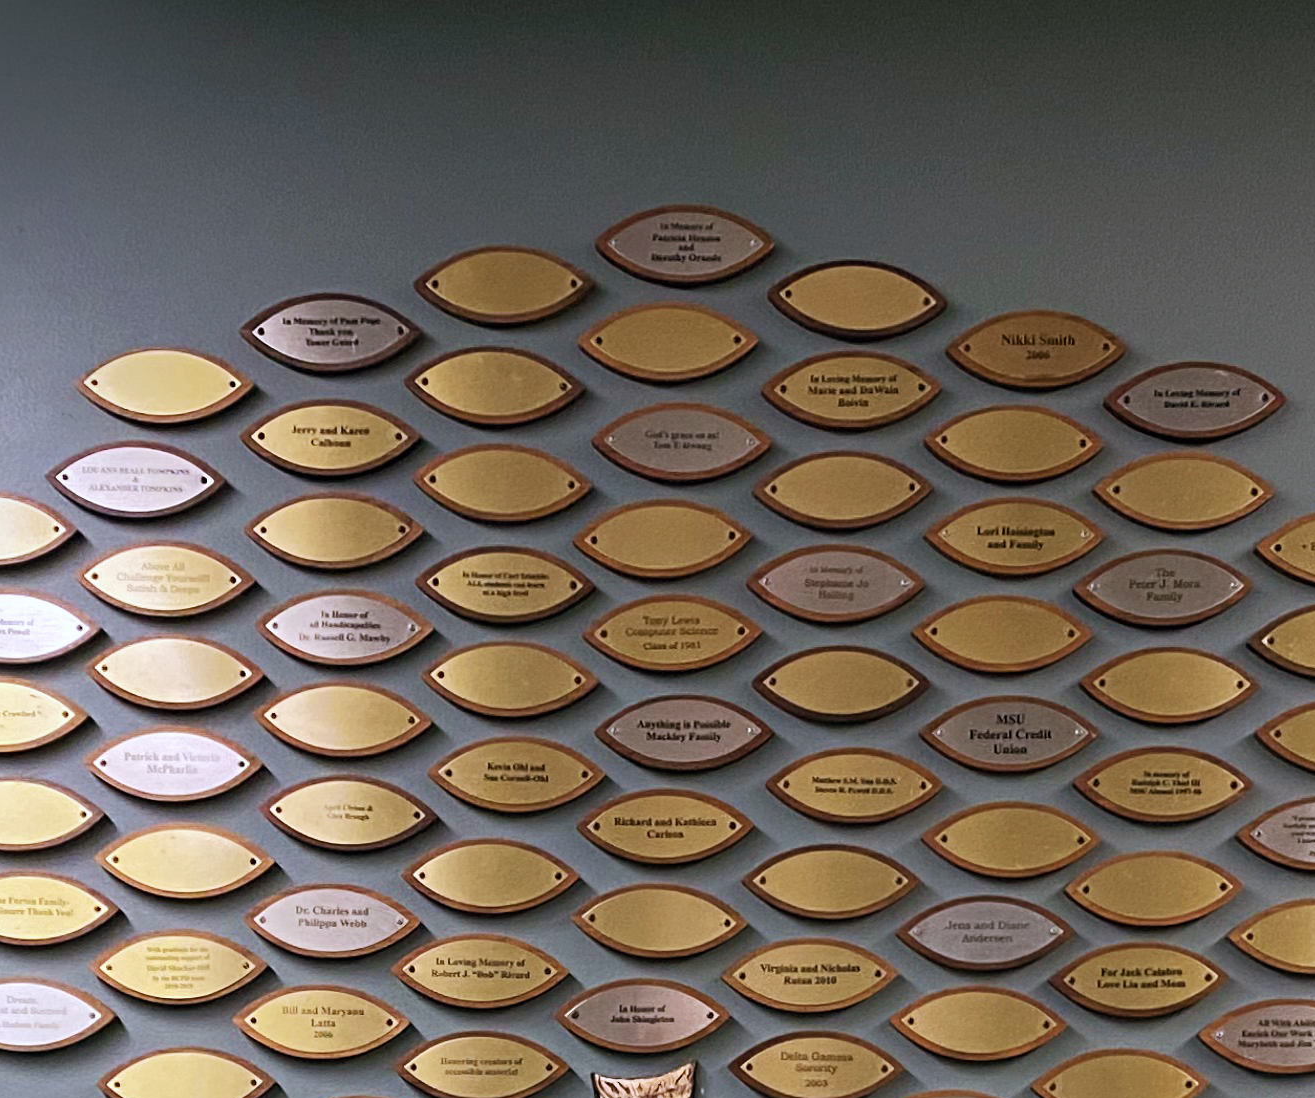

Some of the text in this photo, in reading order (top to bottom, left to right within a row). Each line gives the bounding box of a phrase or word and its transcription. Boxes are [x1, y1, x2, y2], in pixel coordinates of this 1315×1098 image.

[1001, 333, 1076, 347] Nikki Smith
[996, 713, 1025, 726] MSU
[969, 728, 1052, 741] Federal Credit
[993, 743, 1028, 755] Union
